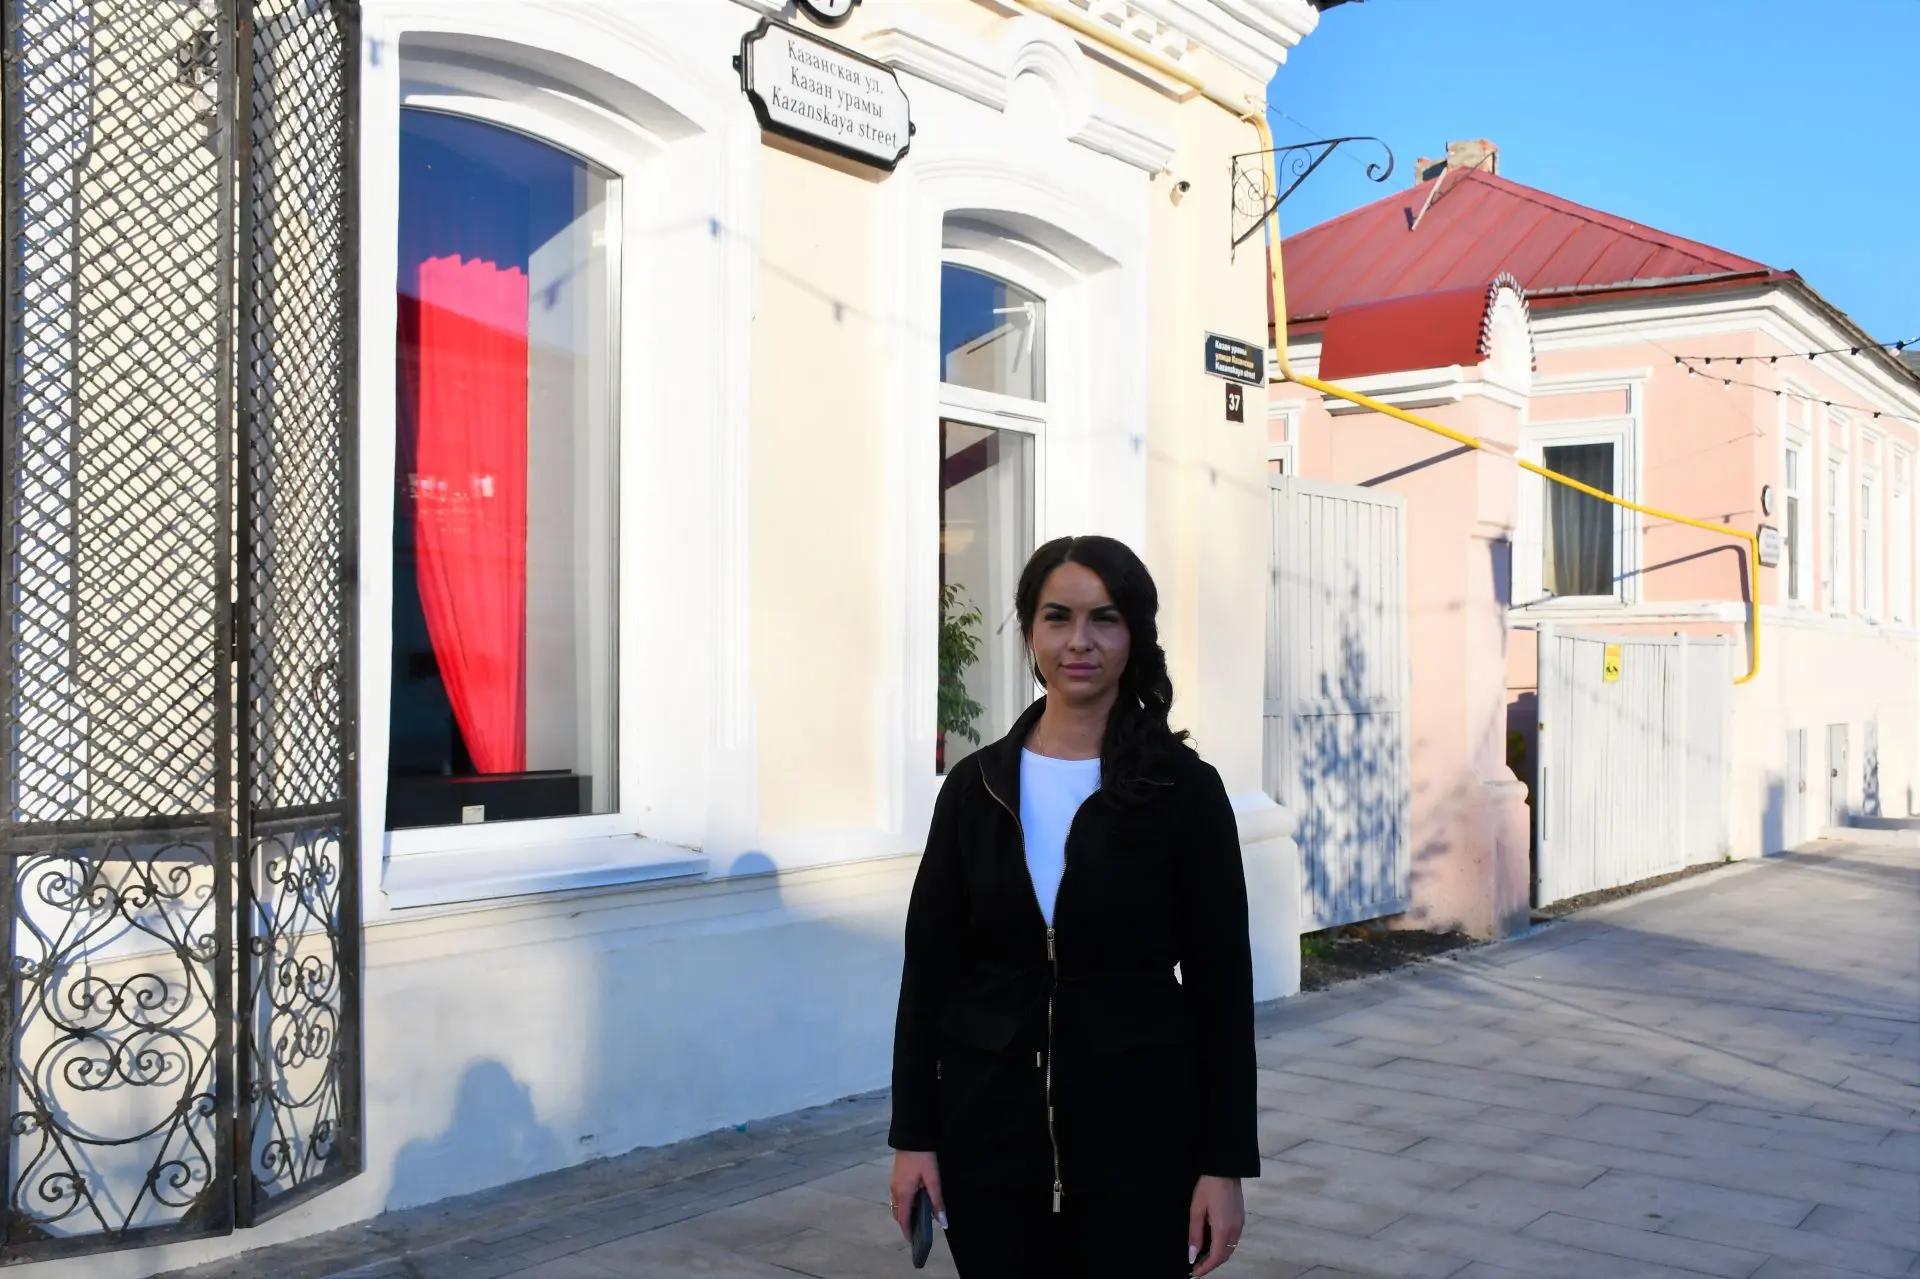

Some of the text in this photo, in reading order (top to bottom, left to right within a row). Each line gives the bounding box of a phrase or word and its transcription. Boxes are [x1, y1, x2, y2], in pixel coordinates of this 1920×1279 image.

[788, 40, 884, 95] Казанская ул.
[791, 66, 883, 119] Казан урамы
[772, 86, 897, 147] Kazanskaya street
[1215, 362, 1255, 379] Kazanskaya street
[1229, 393, 1240, 411] 37
